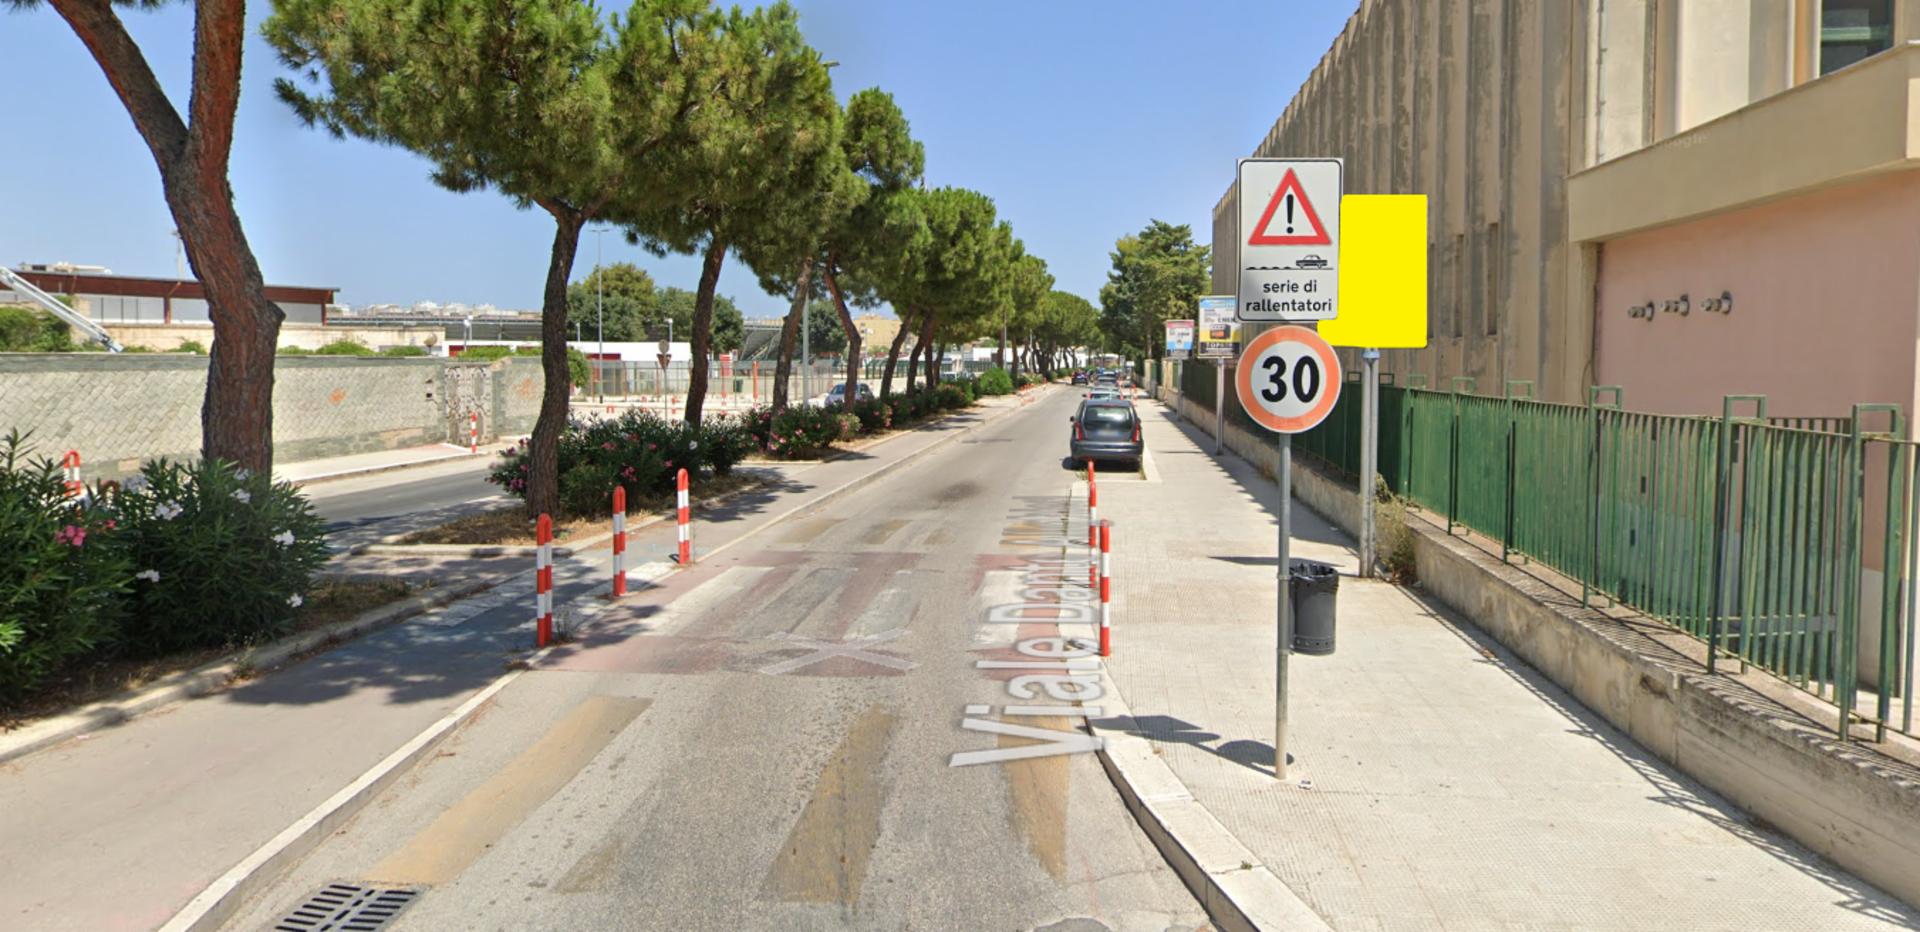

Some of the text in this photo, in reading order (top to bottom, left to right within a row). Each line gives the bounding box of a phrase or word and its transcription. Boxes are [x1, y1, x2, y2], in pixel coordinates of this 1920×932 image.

[1263, 279, 1317, 293] serie di
[1246, 298, 1332, 312] rallentatori
[1261, 355, 1320, 404] 30
